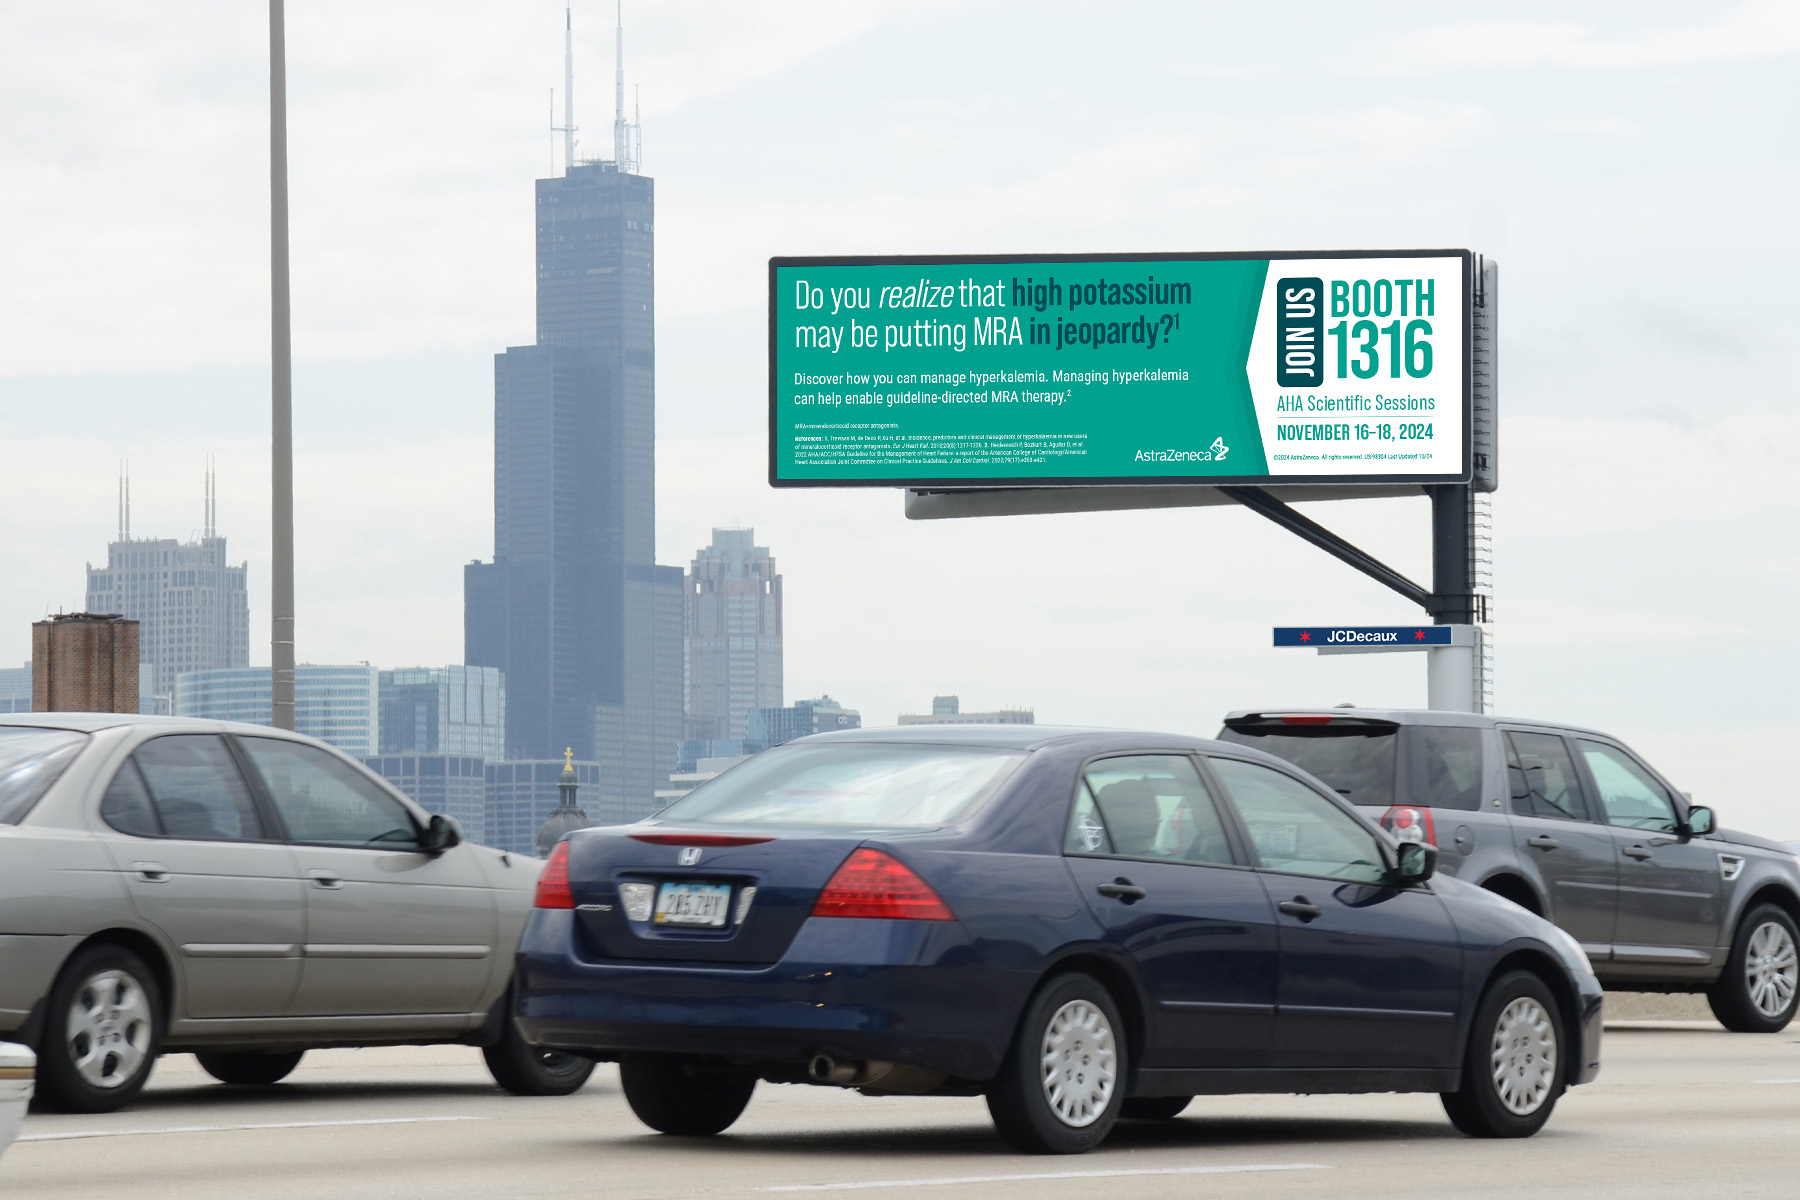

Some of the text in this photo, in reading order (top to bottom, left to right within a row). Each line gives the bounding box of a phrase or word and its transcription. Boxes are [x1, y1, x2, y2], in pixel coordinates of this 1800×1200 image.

[796, 276, 1191, 314] Do you realize that high potassium
[1331, 279, 1434, 317] BOOTH
[796, 326, 844, 353] may
[852, 319, 877, 347] be
[886, 319, 965, 352] putting
[975, 317, 1023, 345] MRA
[1030, 317, 1050, 344] in
[1286, 288, 1315, 377] JOIN US
[1328, 319, 1433, 379] 1316
[795, 368, 1188, 387] Discover how you can manage hyperkalemia. Managing hyperkalemia
[795, 395, 814, 404] can
[818, 392, 841, 407] help
[846, 392, 883, 404] enable
[887, 390, 987, 407] guideline-directed
[992, 391, 1018, 402] MRA
[1277, 395, 1435, 411] AHA Scientific Sessions
[1278, 424, 1349, 440] NOVEMBER
[1399, 423, 1433, 439] 2024
[1135, 449, 1212, 461] AstraZeneca
[1327, 631, 1397, 642] JCDecaux
